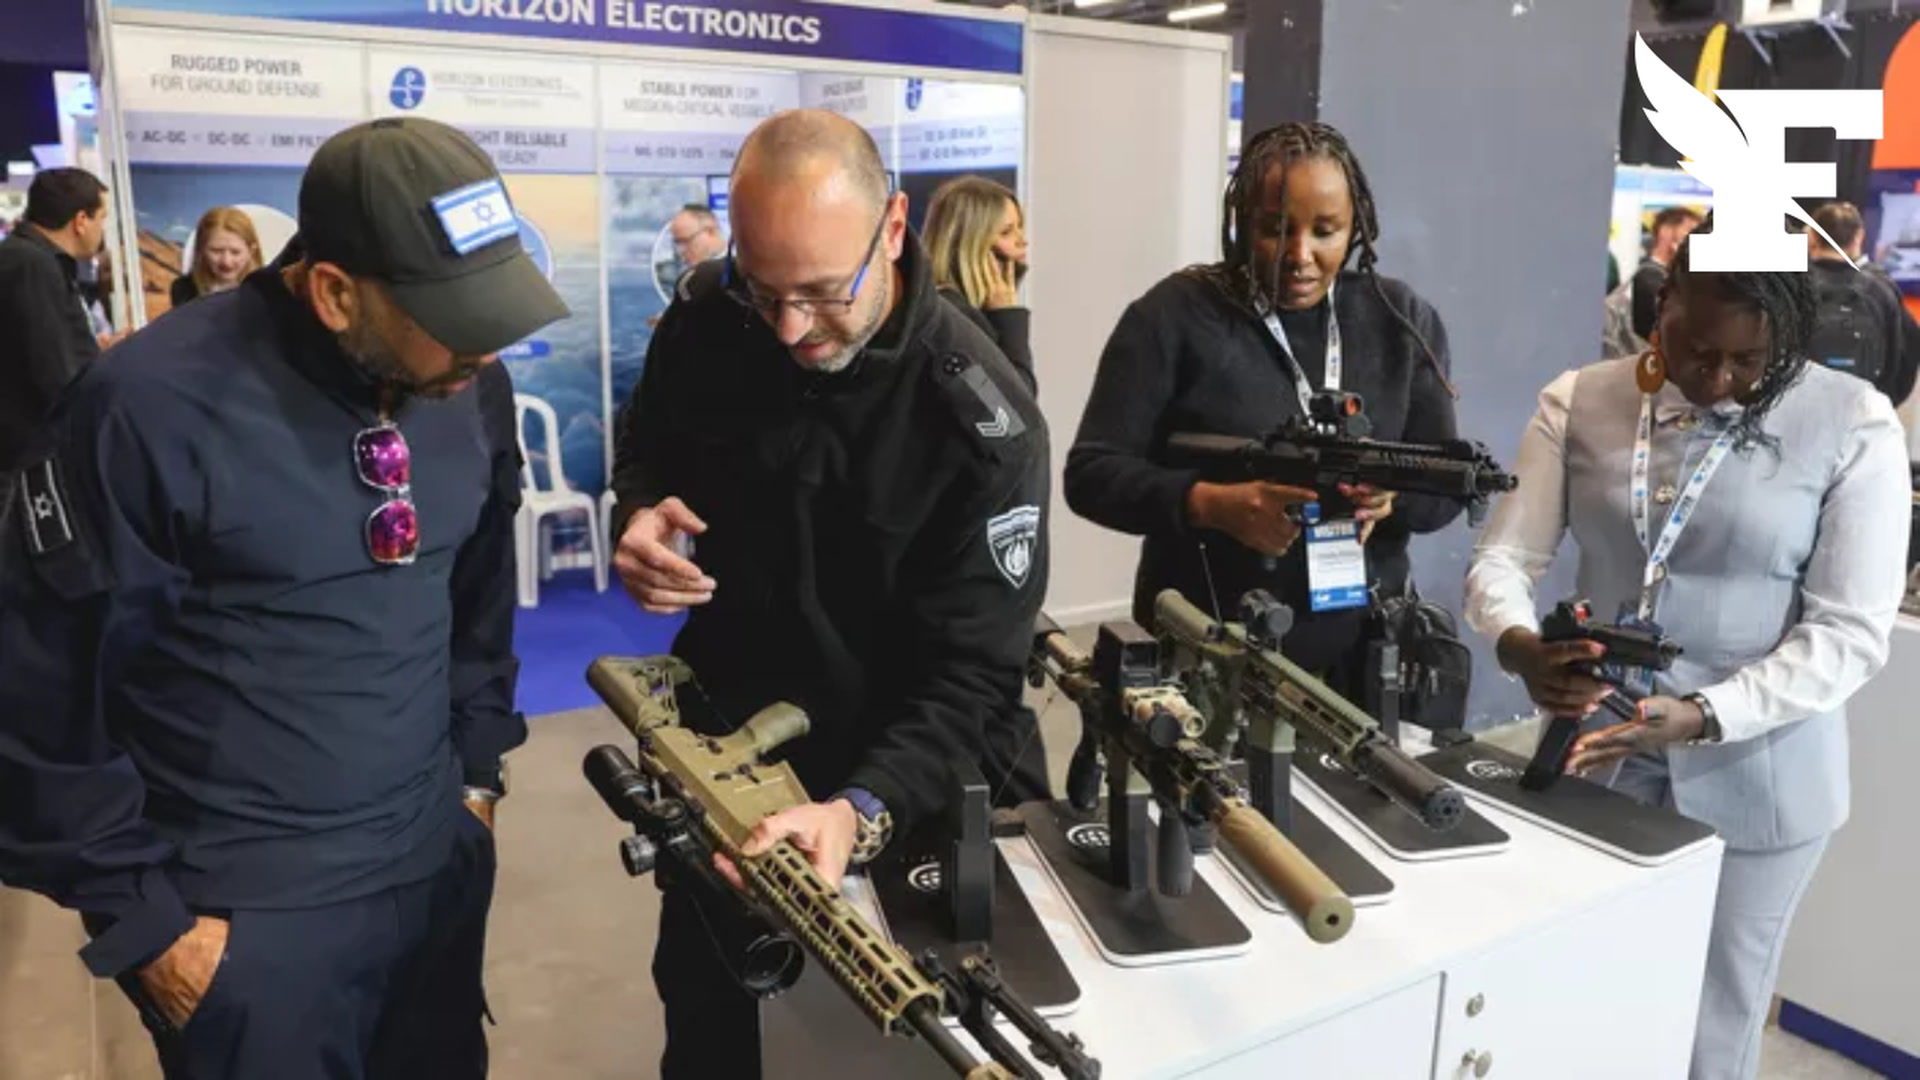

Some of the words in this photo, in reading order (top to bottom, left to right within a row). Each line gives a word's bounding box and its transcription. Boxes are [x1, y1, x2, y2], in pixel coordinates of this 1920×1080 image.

[606, 0, 820, 43] ELECTRONICS
[171, 54, 240, 72] RUGGED
[245, 58, 302, 76] POWER
[151, 74, 183, 91] FOR
[188, 76, 252, 95] GROUND
[258, 80, 322, 98] DEFENSE
[640, 81, 686, 97] STABLE
[690, 84, 734, 98] POWER
[141, 130, 187, 144] AC-DC
[207, 132, 251, 145] DC-DC
[298, 134, 326, 148] FILT
[504, 132, 568, 147] RELIABLE
